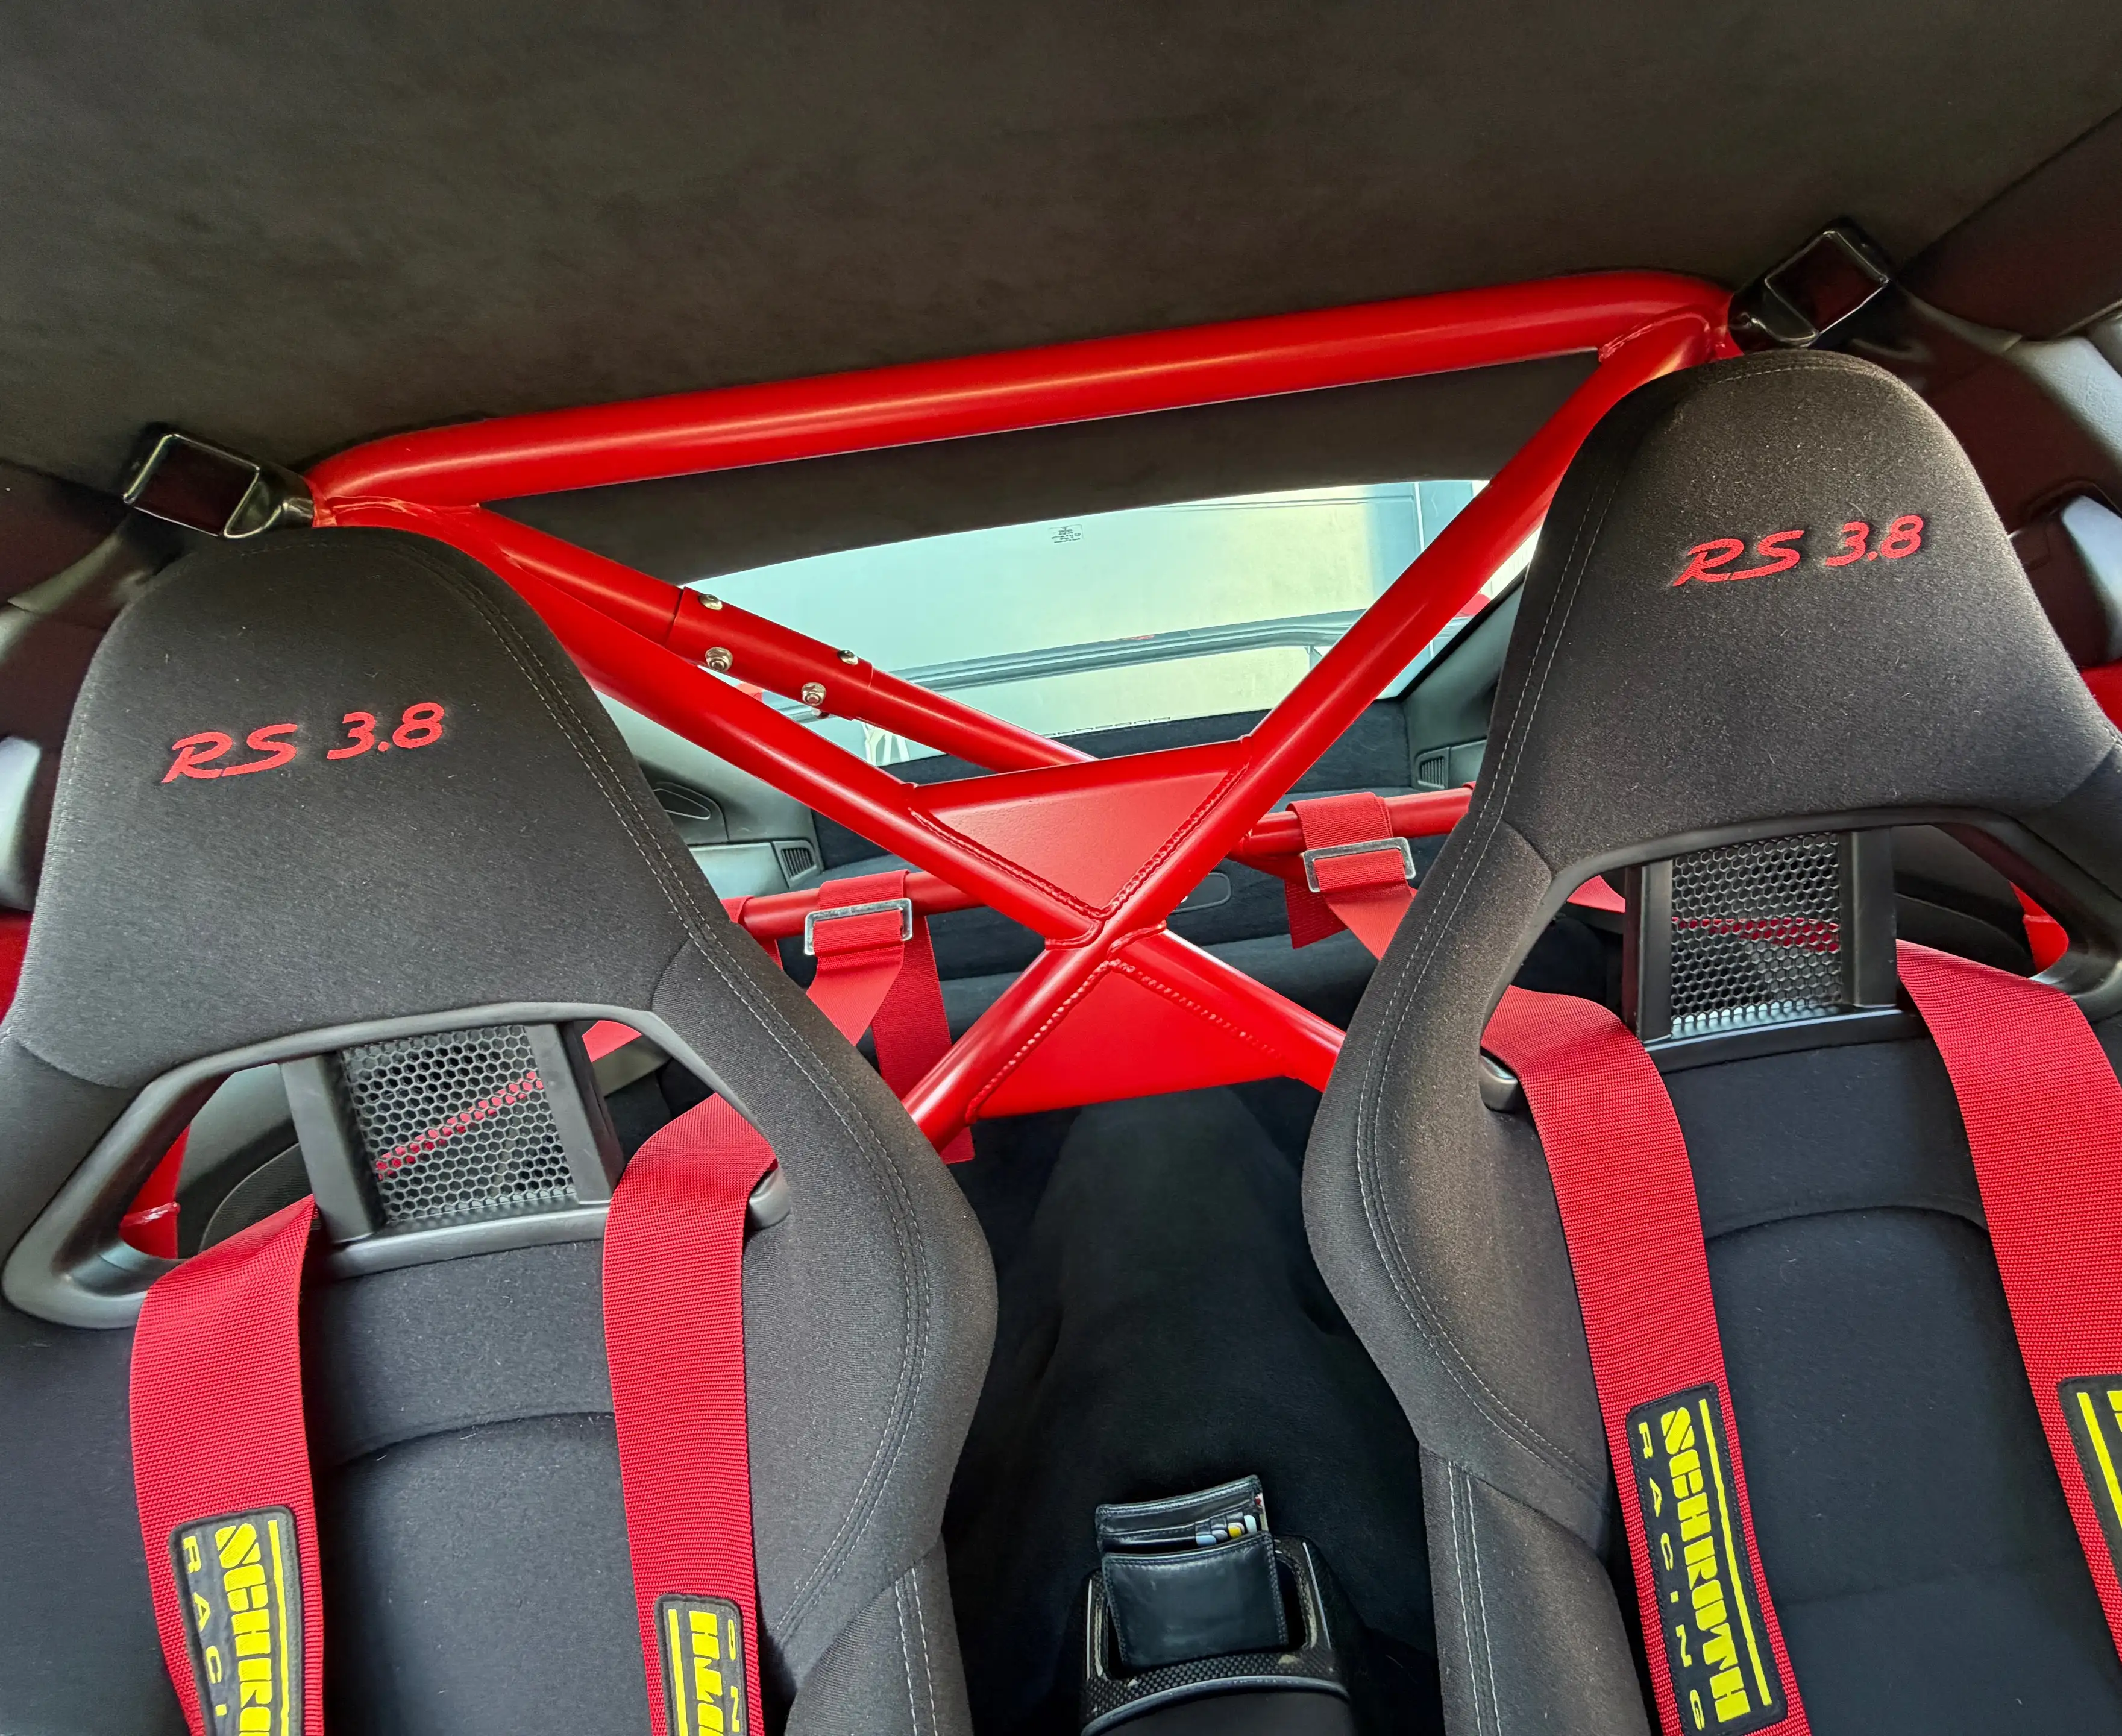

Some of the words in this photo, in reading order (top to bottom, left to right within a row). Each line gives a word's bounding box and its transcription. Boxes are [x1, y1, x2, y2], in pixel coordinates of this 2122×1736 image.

[1672, 530, 1804, 587] RS
[1825, 514, 1924, 567] 3.8
[162, 723, 298, 783] RS
[326, 702, 445, 760] 3.8
[215, 1523, 272, 1736] SCHRO
[1660, 1407, 1751, 1723] SCHROTH
